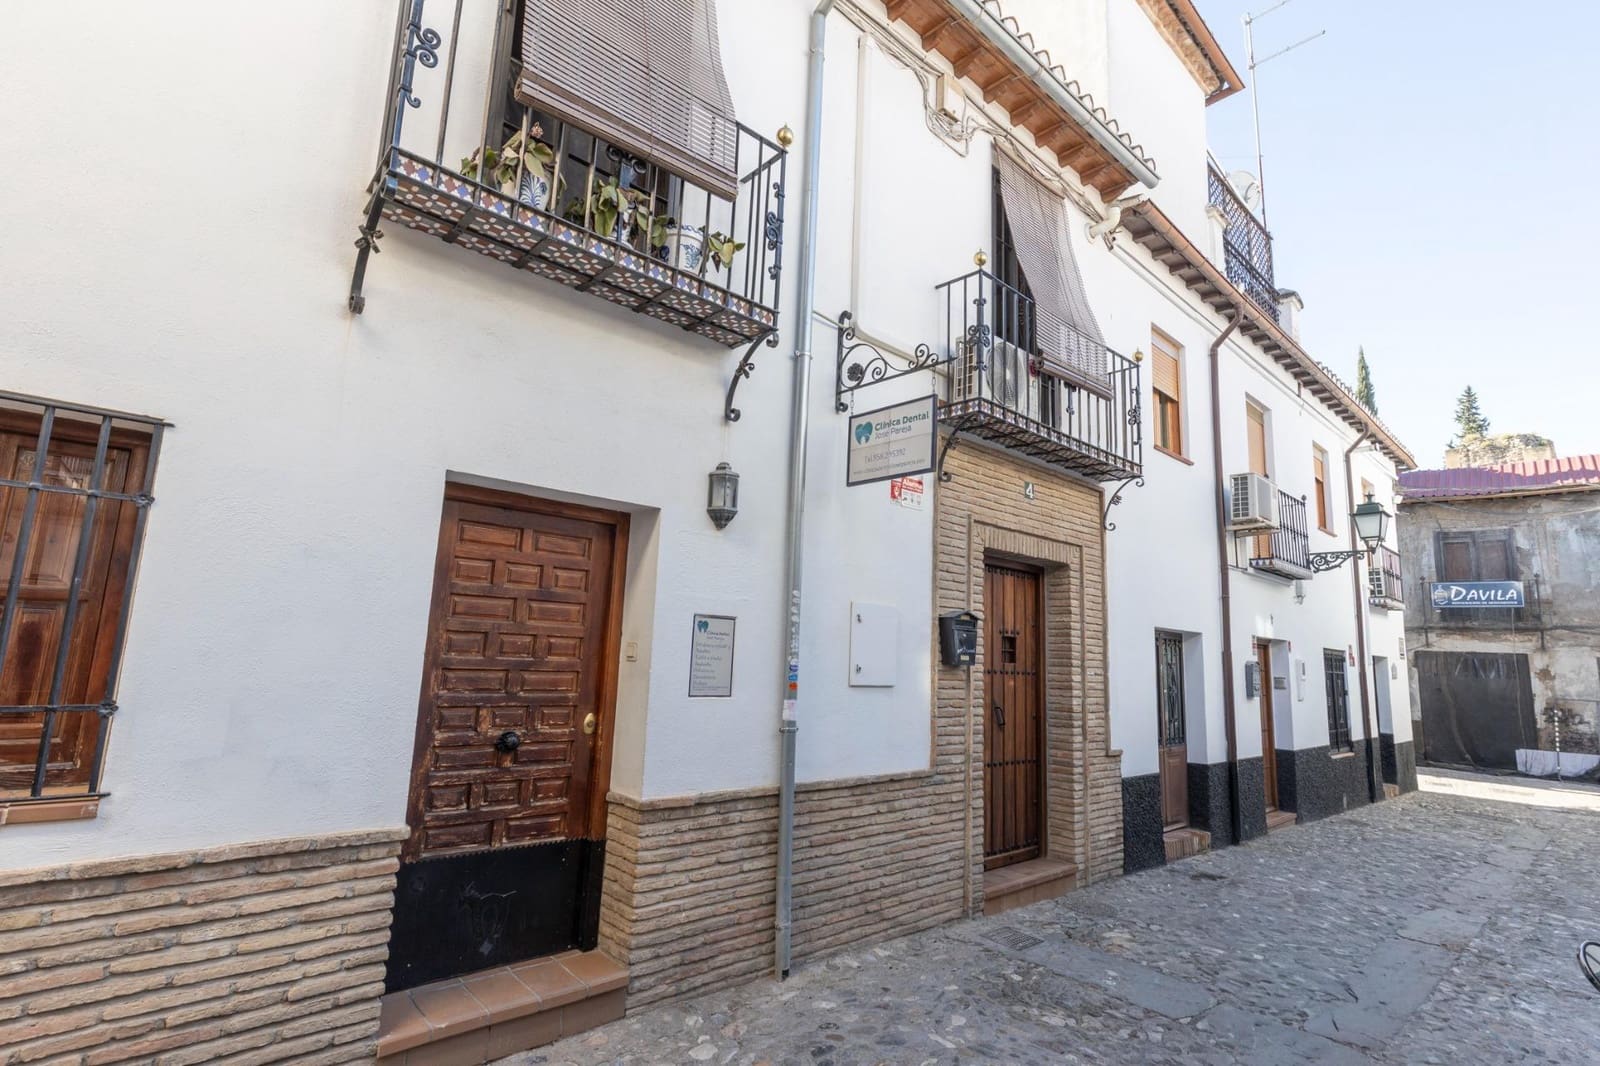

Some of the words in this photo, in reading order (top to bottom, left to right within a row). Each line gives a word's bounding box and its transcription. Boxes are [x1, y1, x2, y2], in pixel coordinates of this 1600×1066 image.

[902, 411, 929, 424] Dental
[1026, 483, 1034, 499] 4
[1450, 585, 1517, 601] DAVILA
